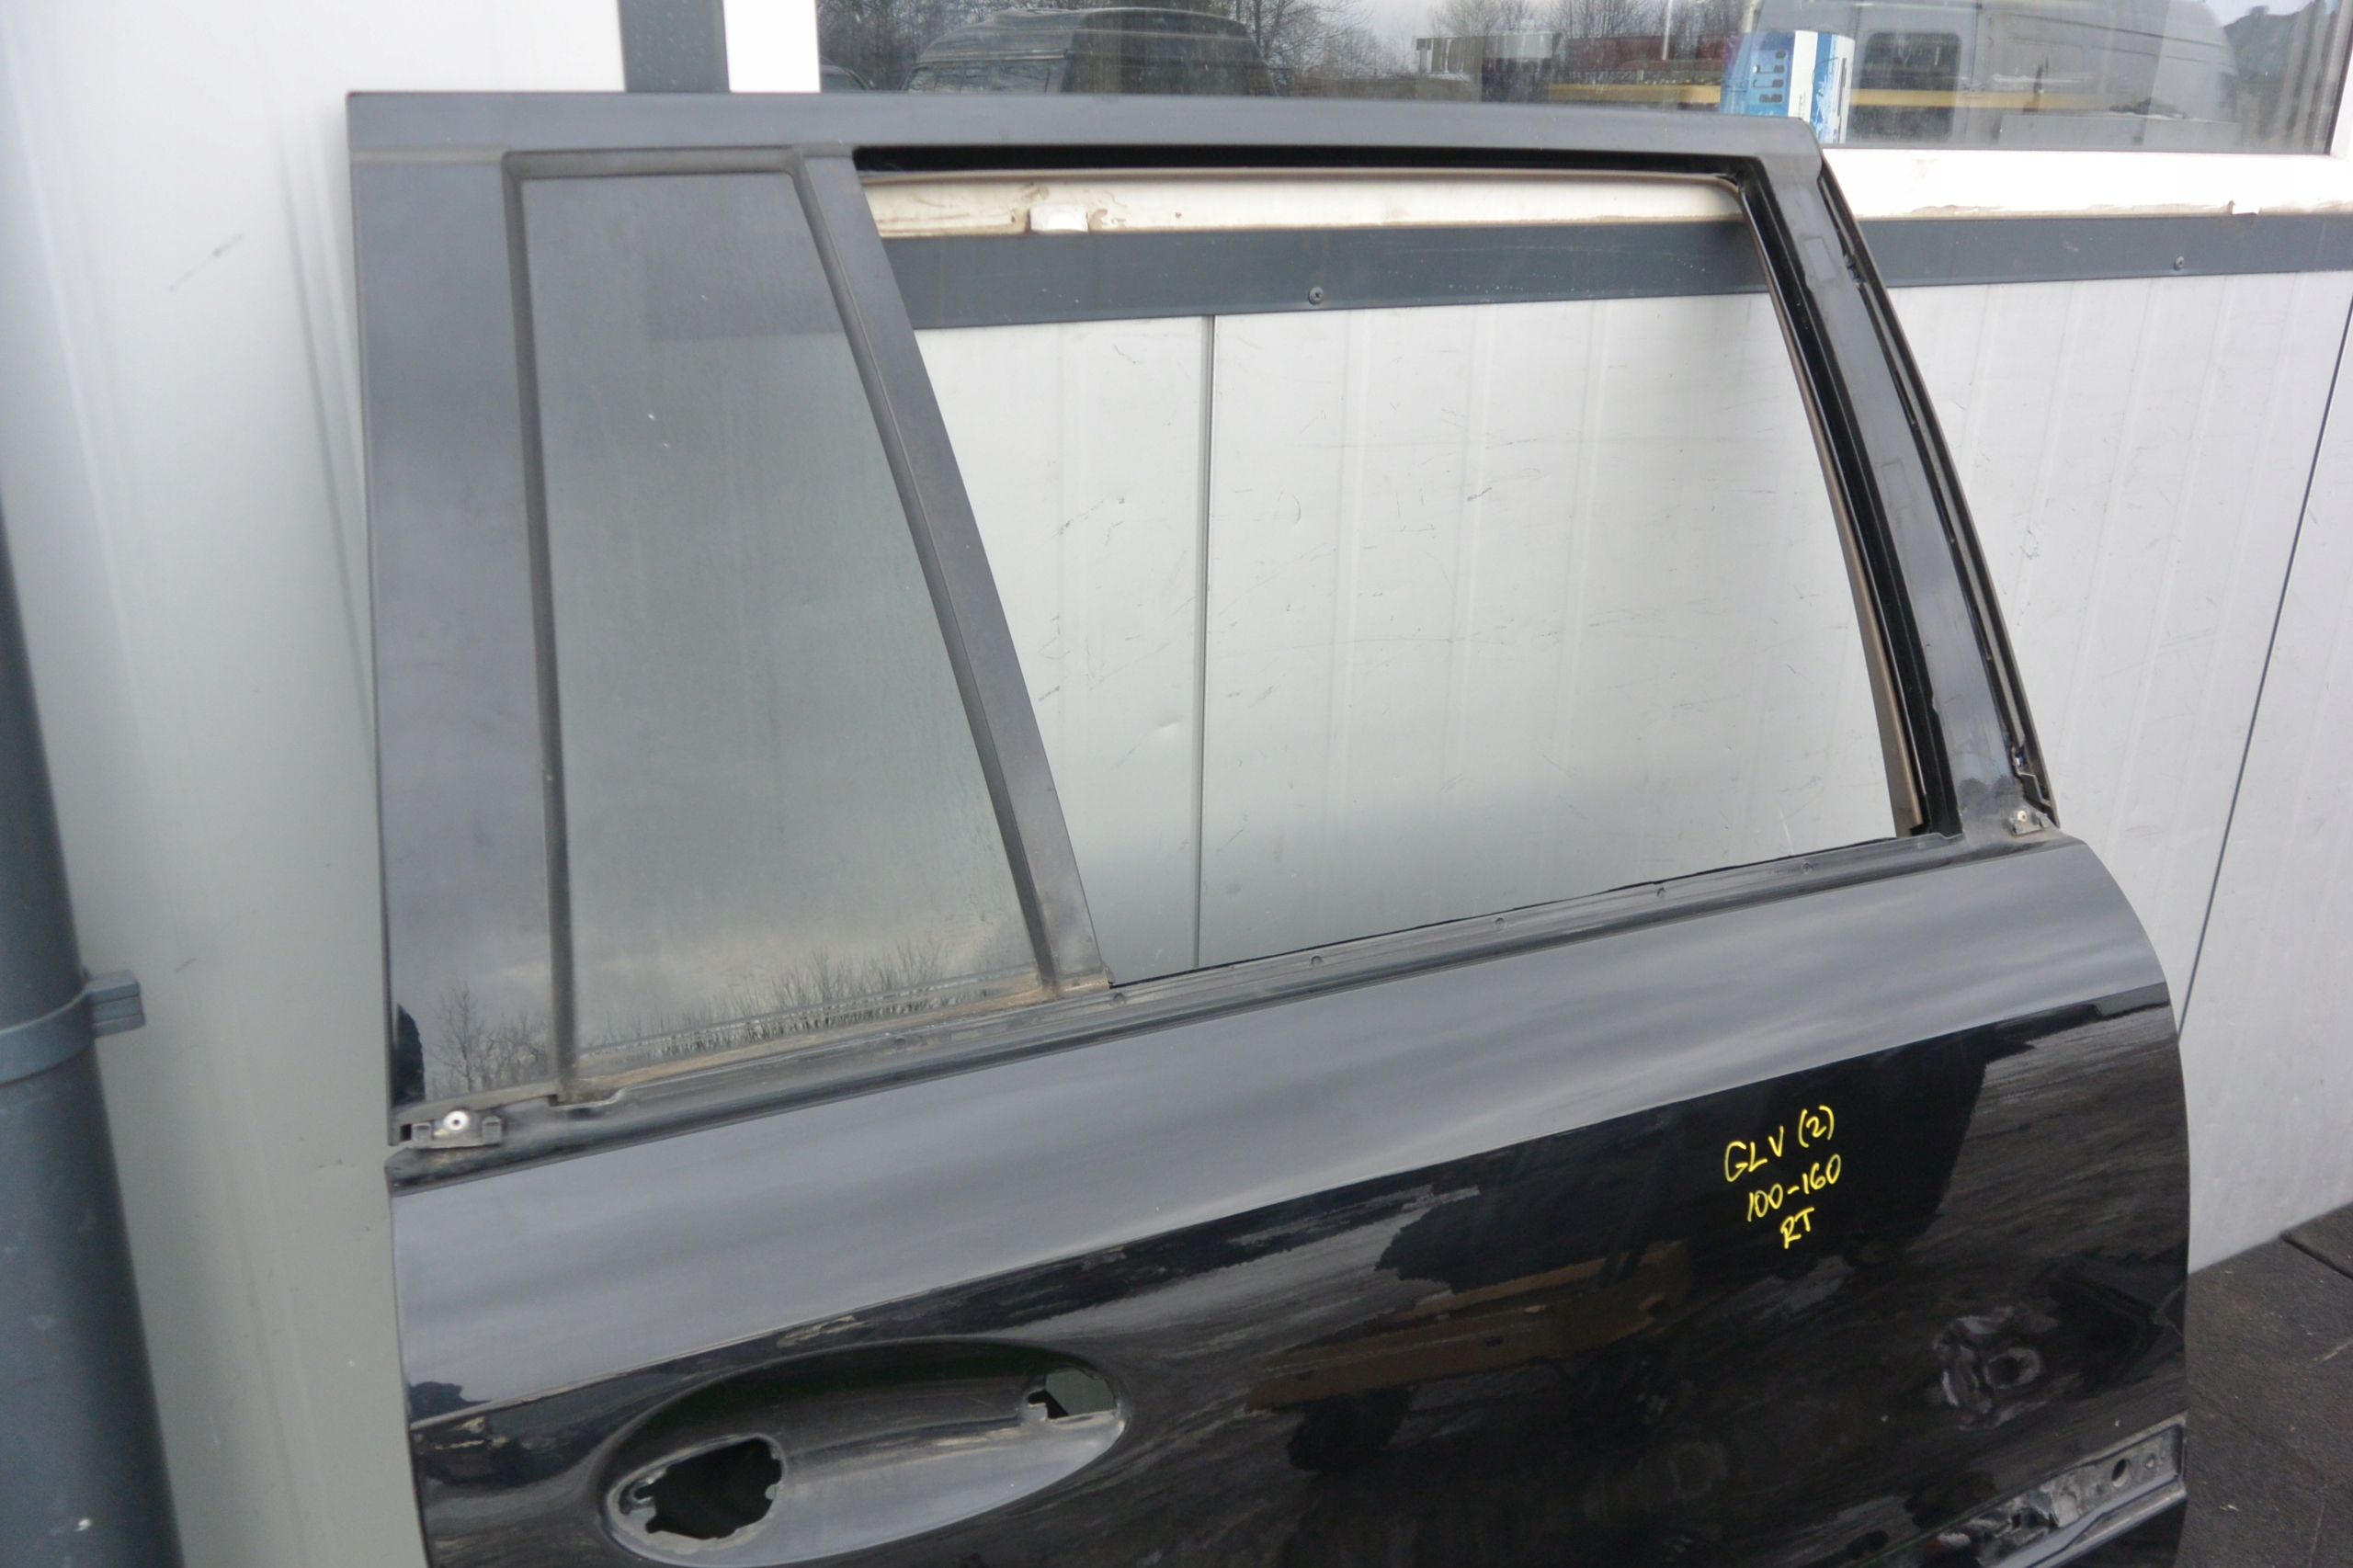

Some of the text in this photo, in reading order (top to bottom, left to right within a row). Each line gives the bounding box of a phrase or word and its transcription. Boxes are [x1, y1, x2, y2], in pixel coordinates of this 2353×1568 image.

[1724, 1105, 1835, 1182] GLV (2)
[1747, 1153, 1842, 1222] 100-160
[1779, 1207, 1815, 1249] RT
